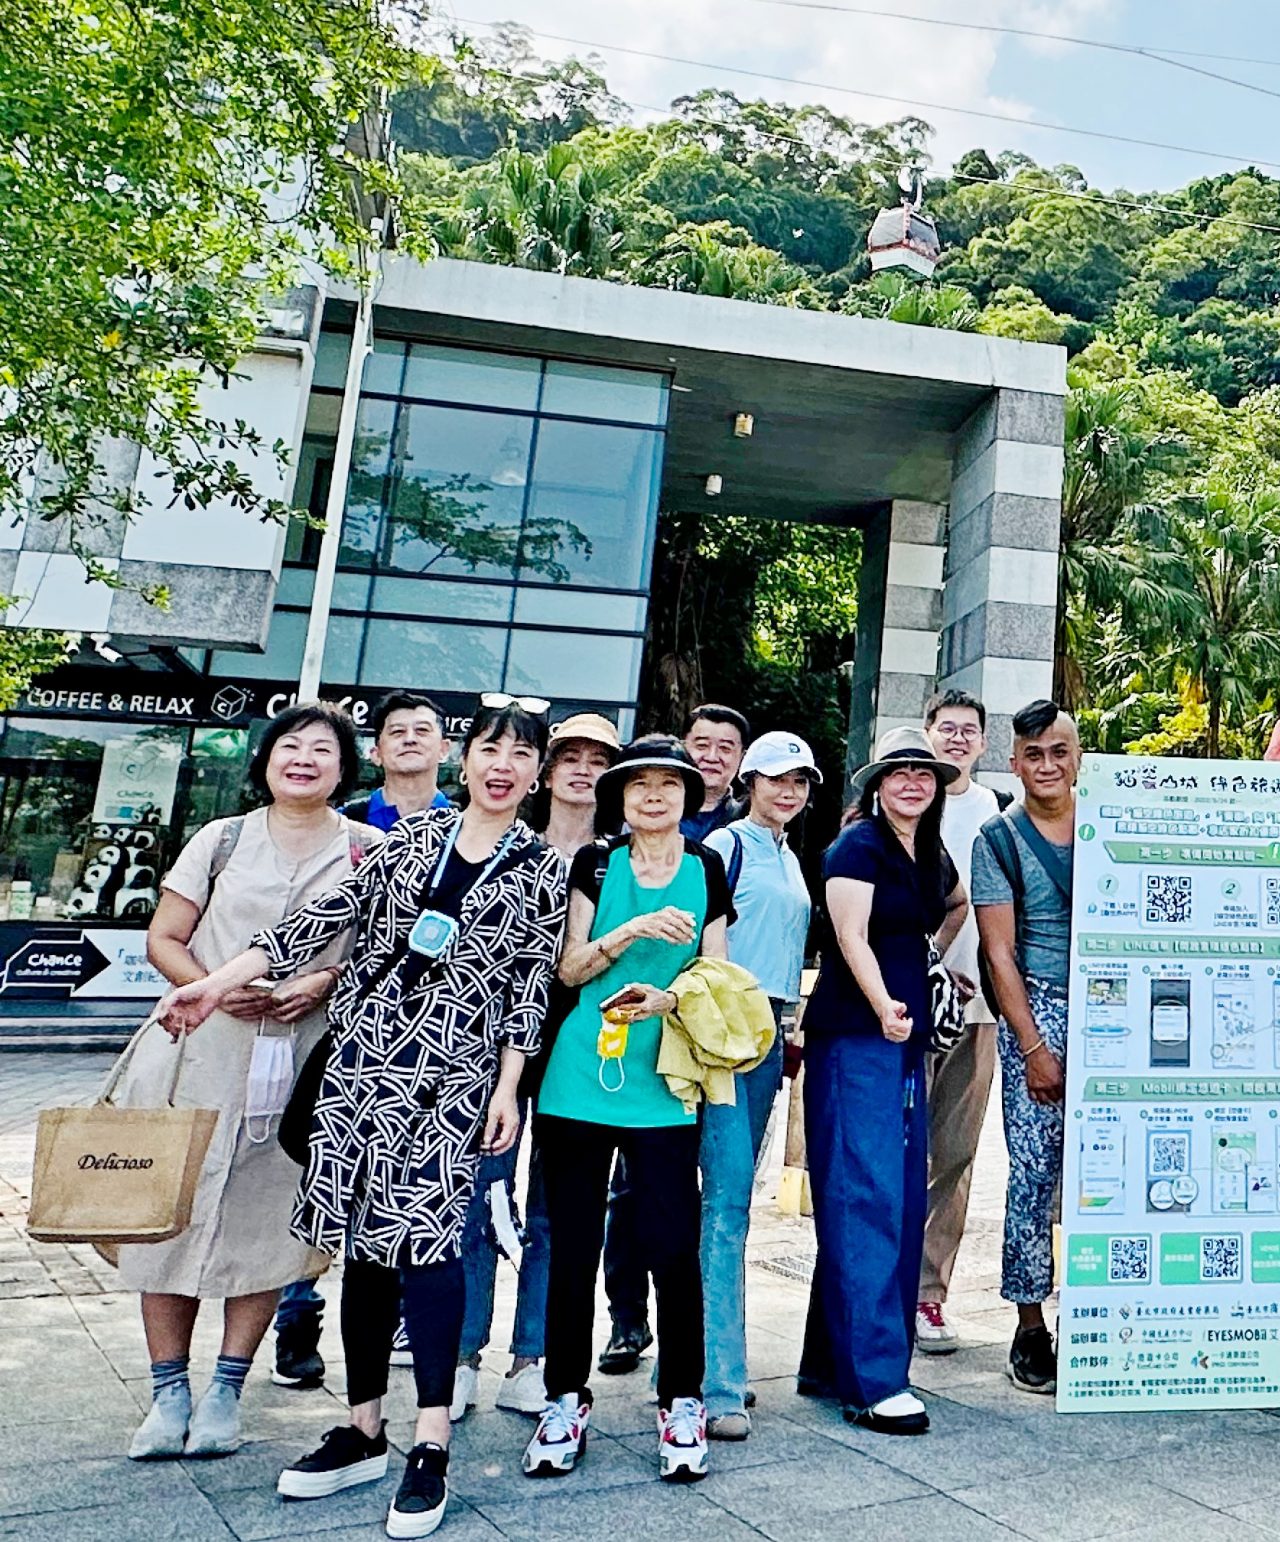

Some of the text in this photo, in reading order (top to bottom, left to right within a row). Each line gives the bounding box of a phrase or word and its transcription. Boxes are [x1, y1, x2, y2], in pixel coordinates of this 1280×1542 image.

[27, 687, 195, 716] COFFEE & RELAX
[1225, 883, 1236, 895] 2
[27, 953, 83, 967] Chance
[77, 1153, 154, 1171] Delicioso
